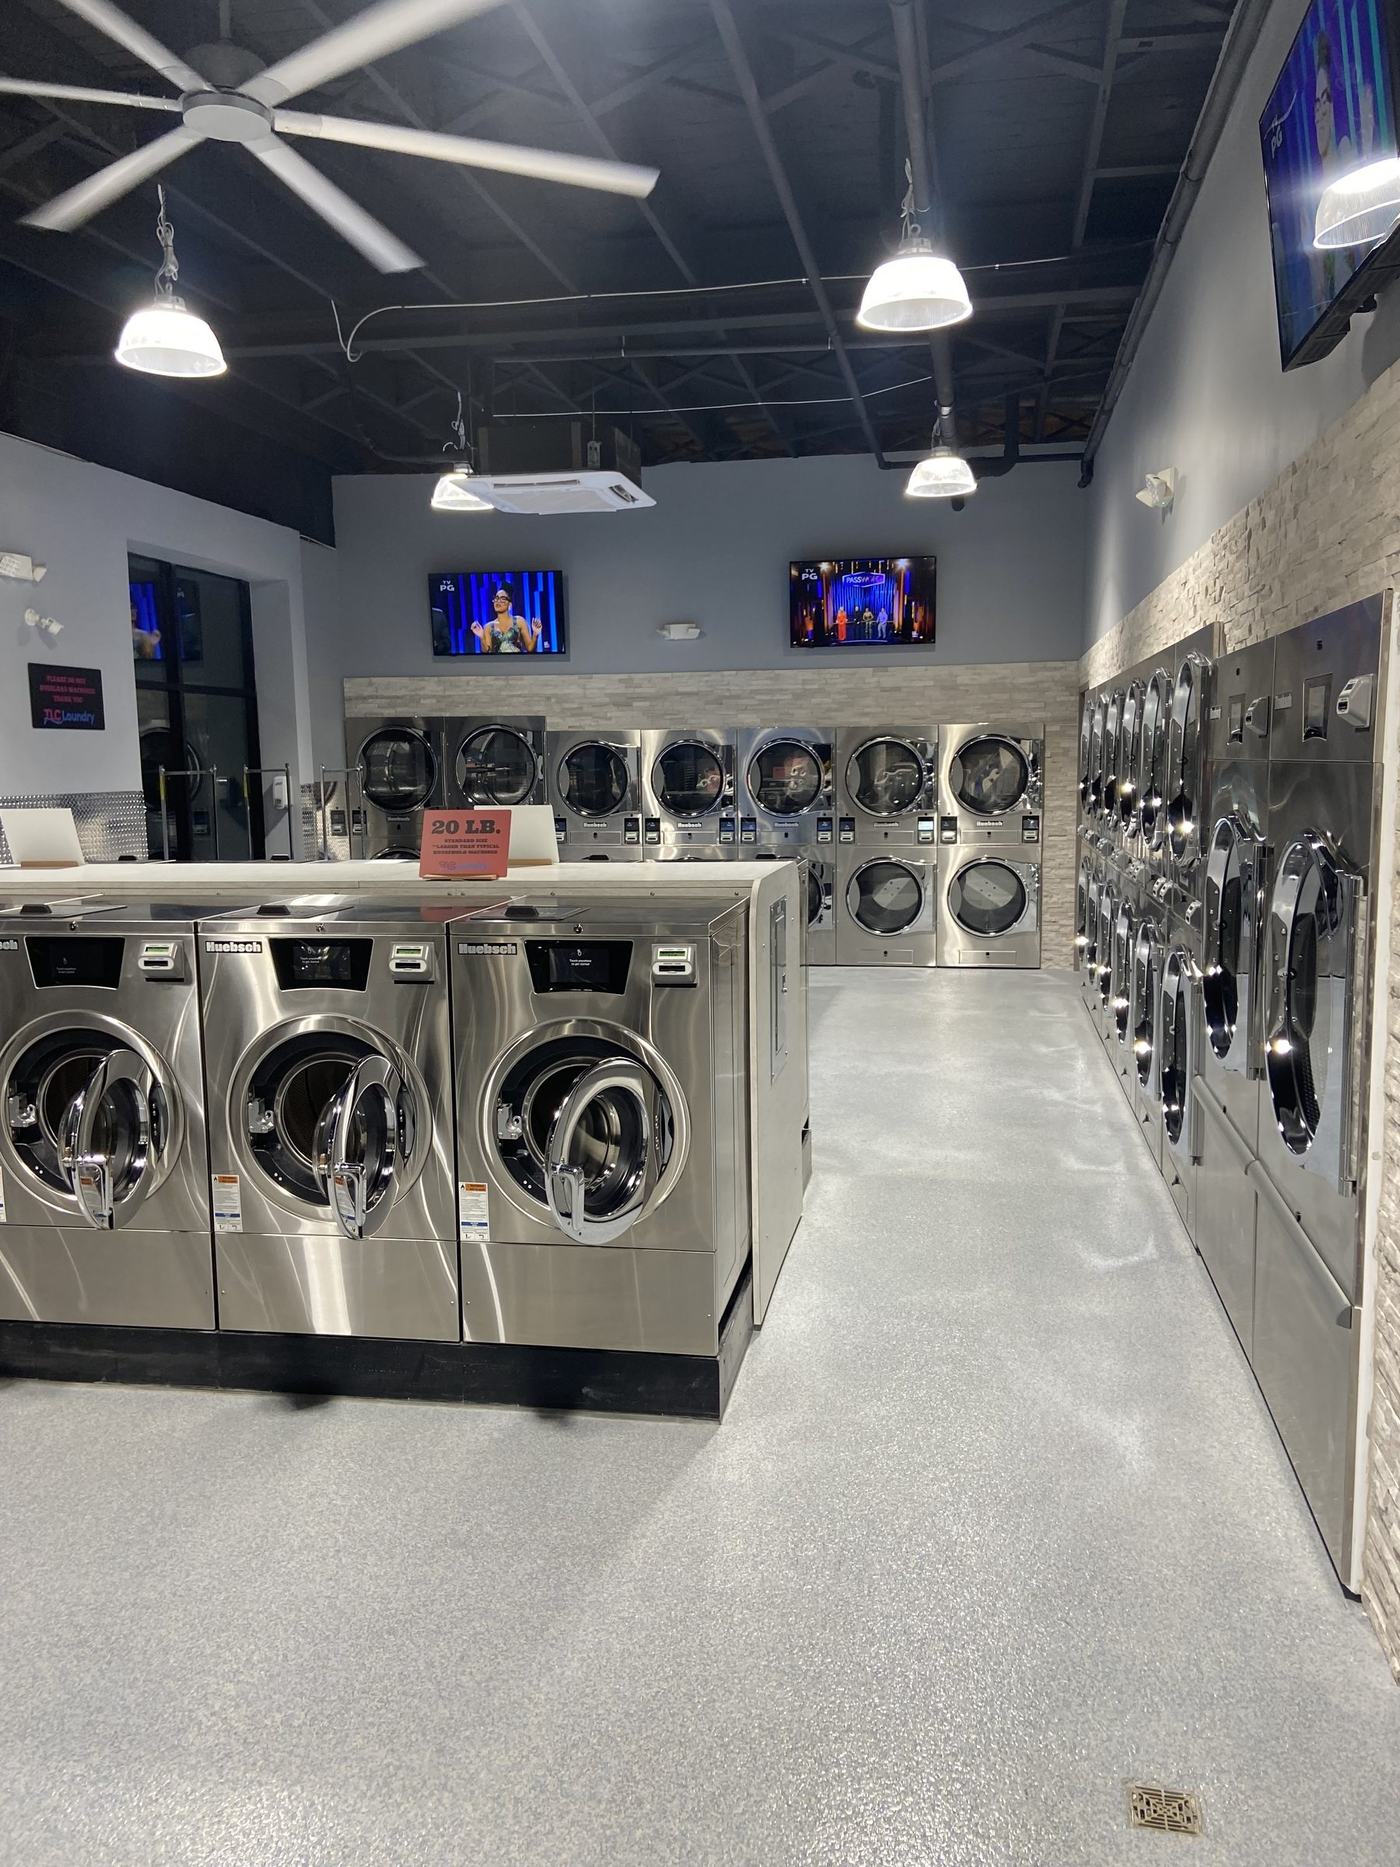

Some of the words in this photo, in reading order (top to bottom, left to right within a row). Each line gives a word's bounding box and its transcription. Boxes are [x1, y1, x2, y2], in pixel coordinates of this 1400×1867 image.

[62, 710, 95, 726] Laundry
[432, 820, 460, 835] 20
[465, 820, 501, 835] LB.
[206, 941, 262, 952] Huebsch
[458, 943, 516, 954] Huebsch
